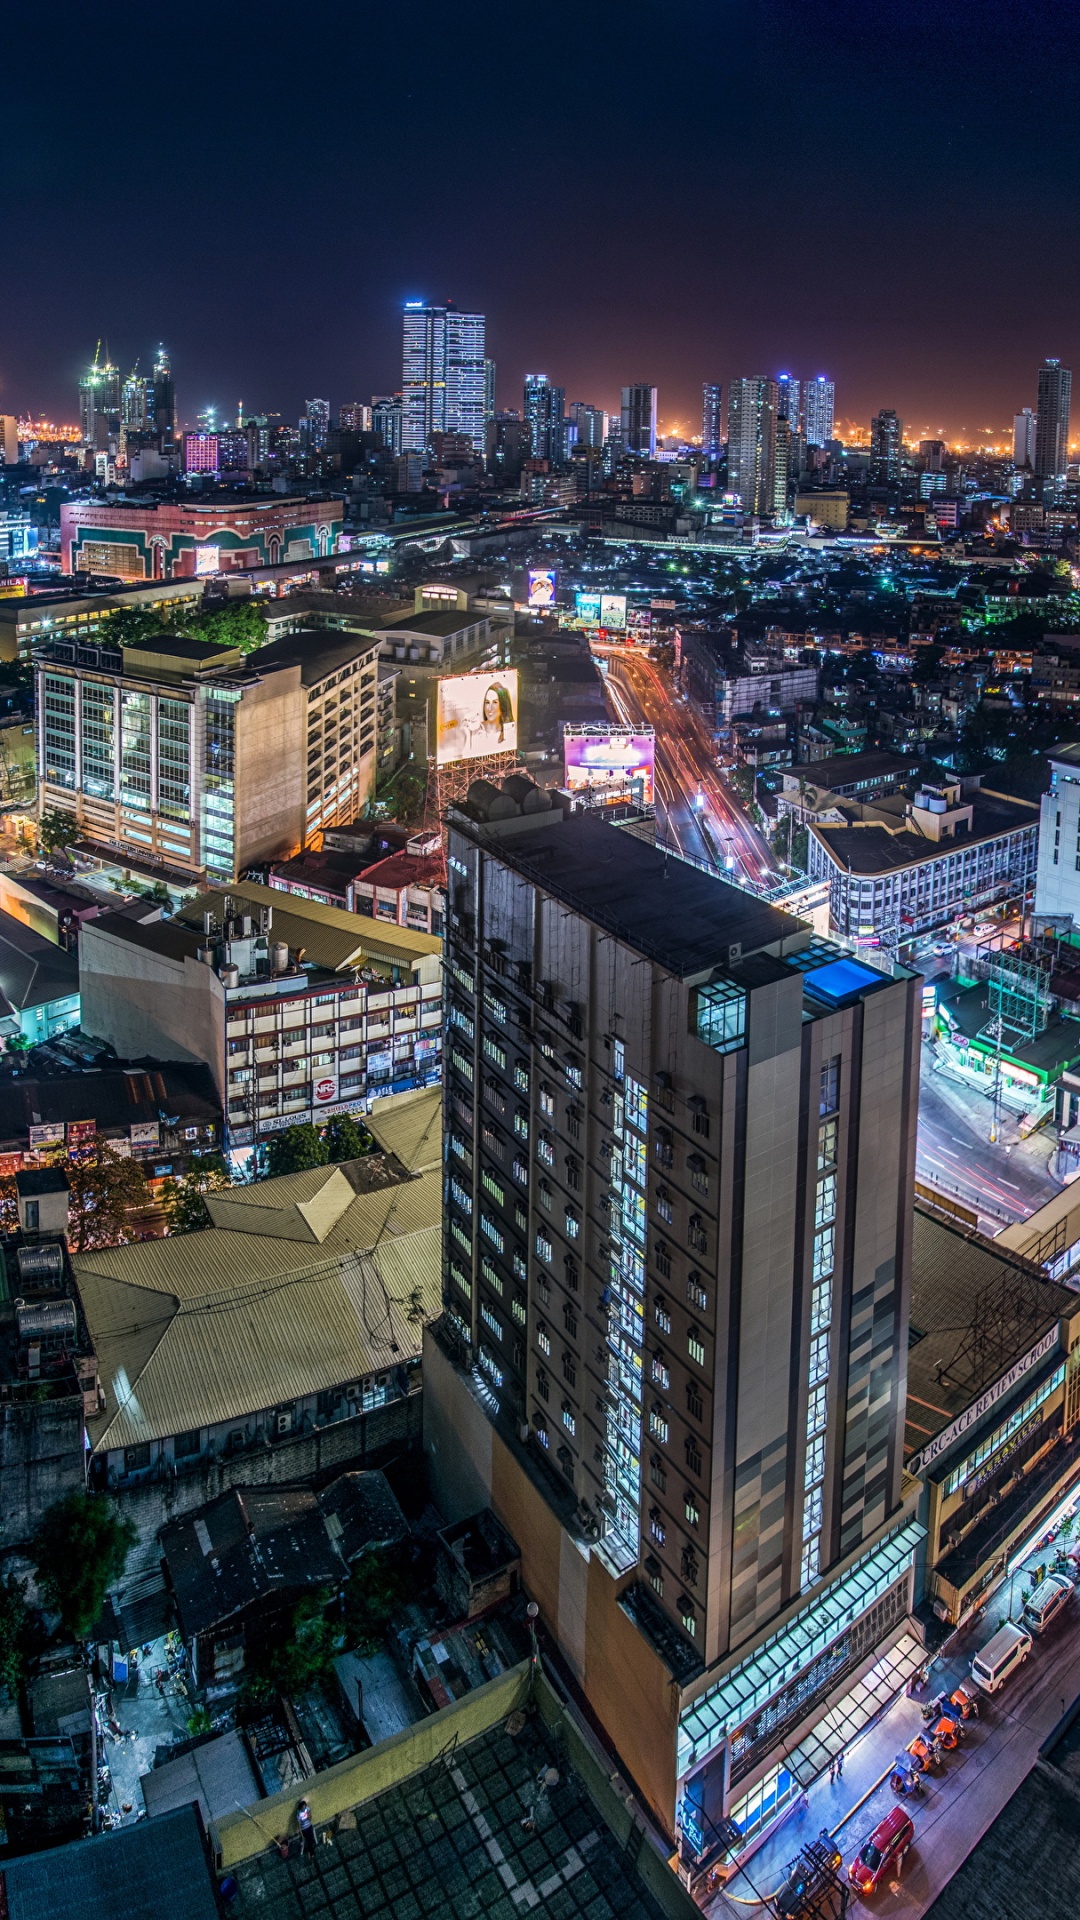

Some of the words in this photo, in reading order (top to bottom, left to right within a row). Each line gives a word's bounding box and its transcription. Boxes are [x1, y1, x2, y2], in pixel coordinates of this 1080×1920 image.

[315, 1081, 336, 1094] NRS
[921, 1408, 974, 1466] CRC-ACE
[975, 1371, 1019, 1418] REVIEW
[1016, 1328, 1058, 1377] SCHOOL
